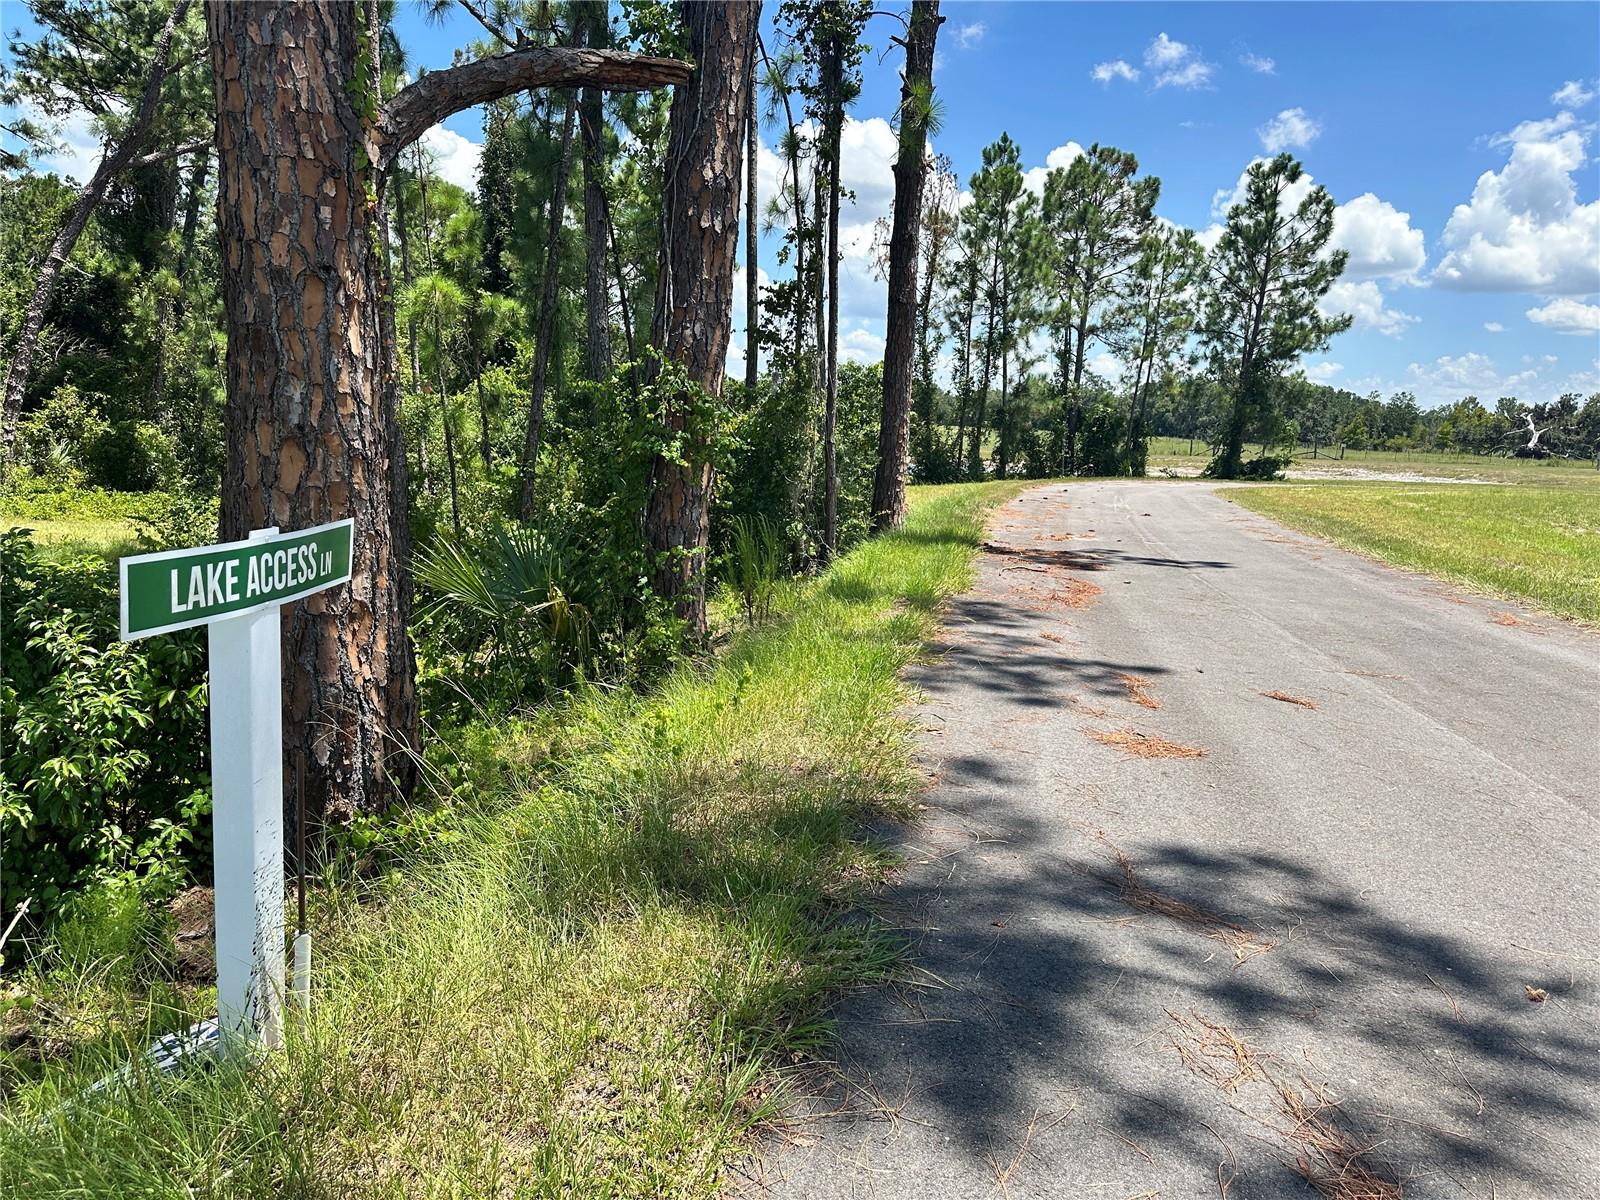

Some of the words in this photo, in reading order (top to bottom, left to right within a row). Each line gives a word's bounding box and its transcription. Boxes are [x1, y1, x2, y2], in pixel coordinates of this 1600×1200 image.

[171, 558, 240, 614] LAKE
[246, 542, 318, 598] ACCESS
[320, 550, 332, 577] LN
